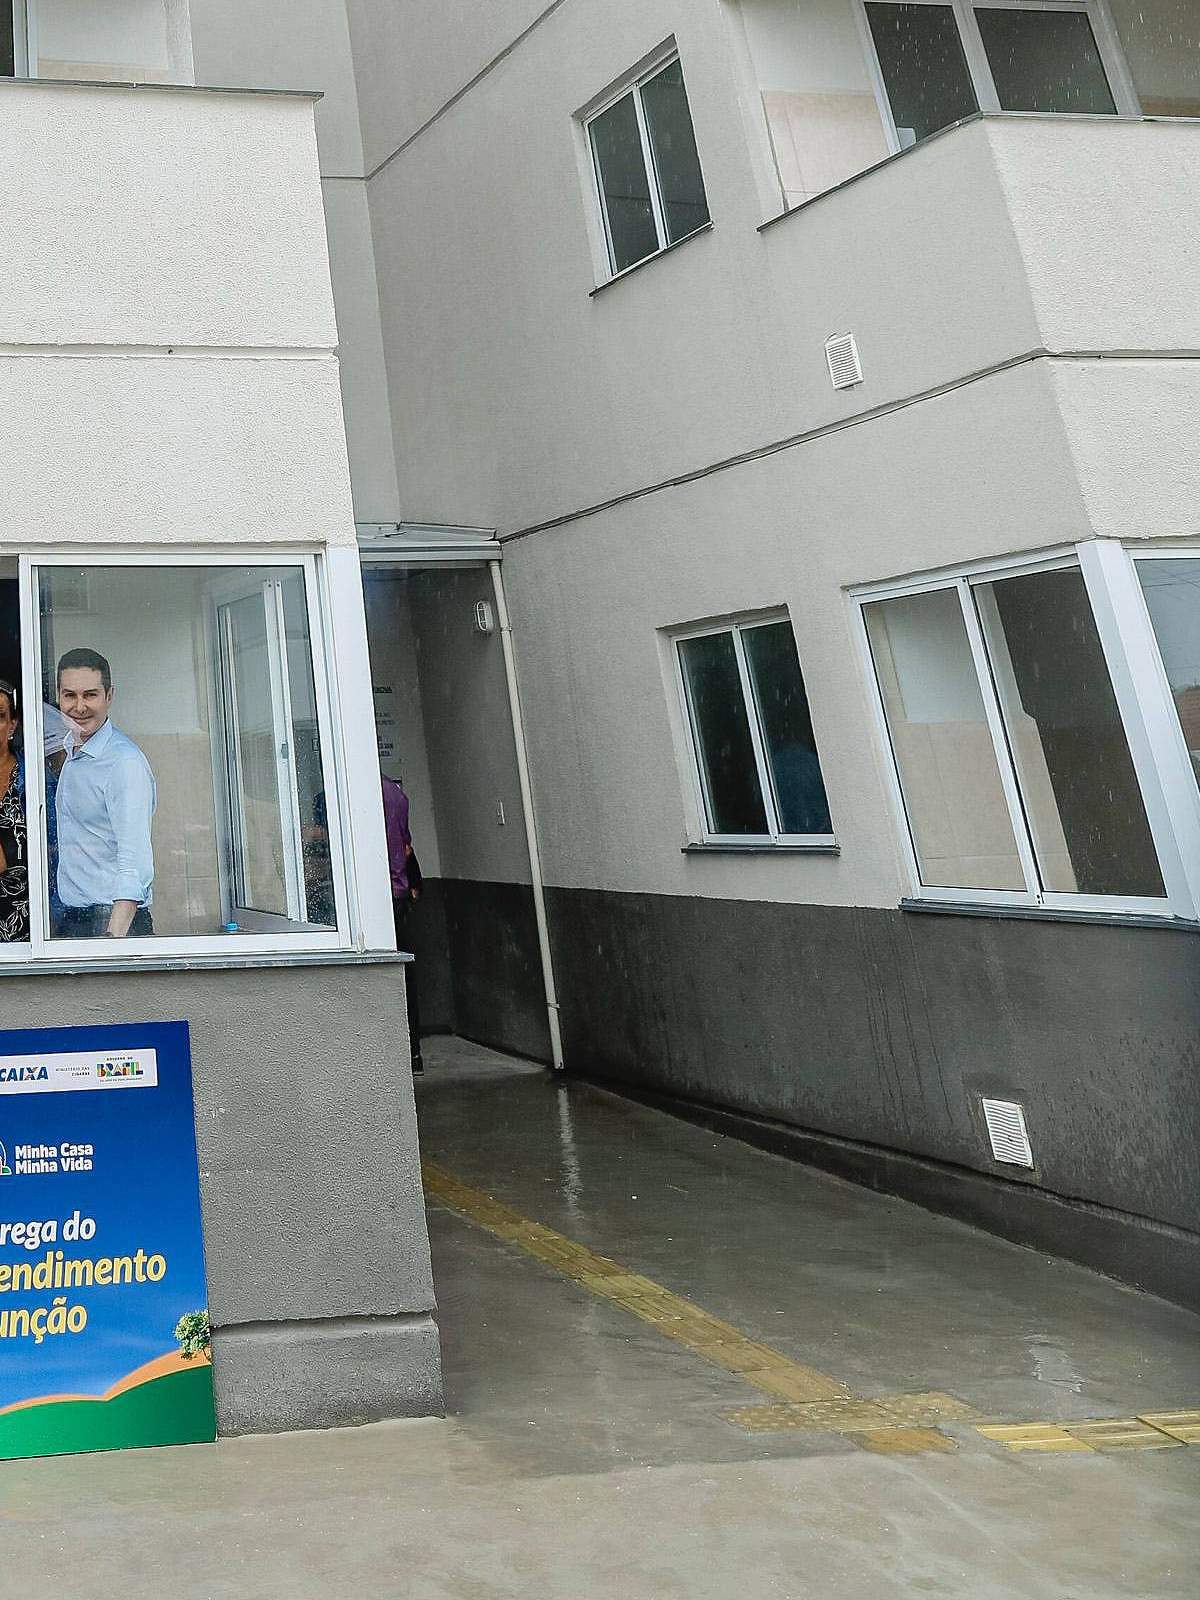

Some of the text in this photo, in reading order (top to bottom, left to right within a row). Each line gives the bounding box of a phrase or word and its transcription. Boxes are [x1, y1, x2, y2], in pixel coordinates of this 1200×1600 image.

[97, 1062, 143, 1077] BRASIL
[15, 1142, 93, 1159] Minha Casa
[15, 1157, 93, 1174] Minha Vida
[62, 1210, 96, 1240] do
